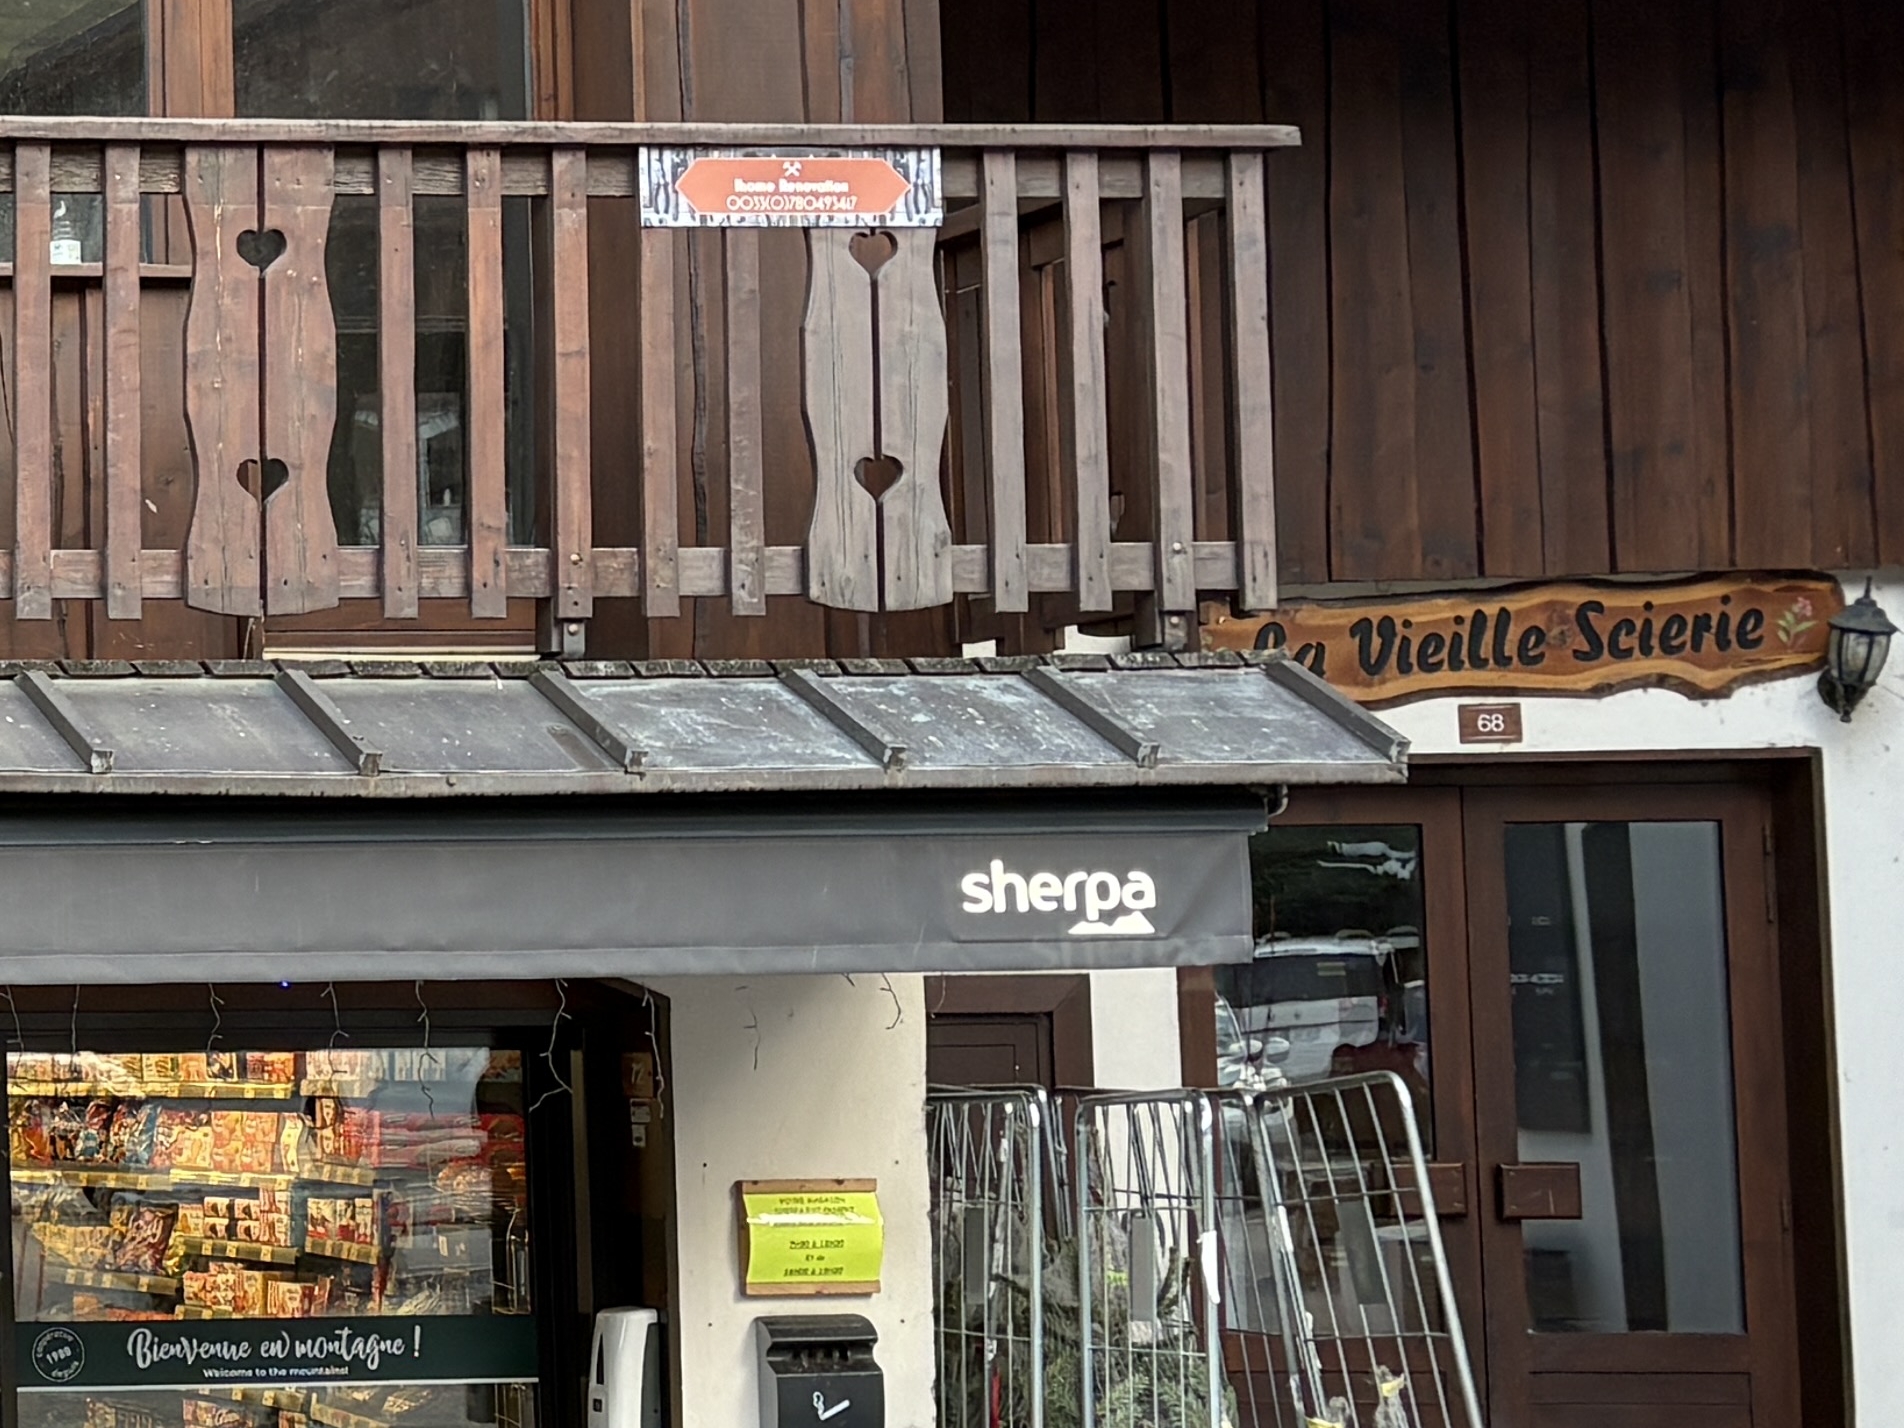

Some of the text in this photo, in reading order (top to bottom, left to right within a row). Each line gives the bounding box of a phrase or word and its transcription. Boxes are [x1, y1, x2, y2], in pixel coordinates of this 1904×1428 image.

[1349, 606, 1547, 677] Vieille
[1571, 594, 1765, 663] Scierie
[1476, 713, 1505, 732] 68
[960, 858, 1157, 922] sherpa
[126, 1327, 252, 1370] Bienvenue
[260, 1329, 291, 1359] en
[294, 1326, 405, 1371] montagne
[202, 1367, 253, 1379] Welcome
[255, 1367, 267, 1378] to
[269, 1366, 286, 1377] the
